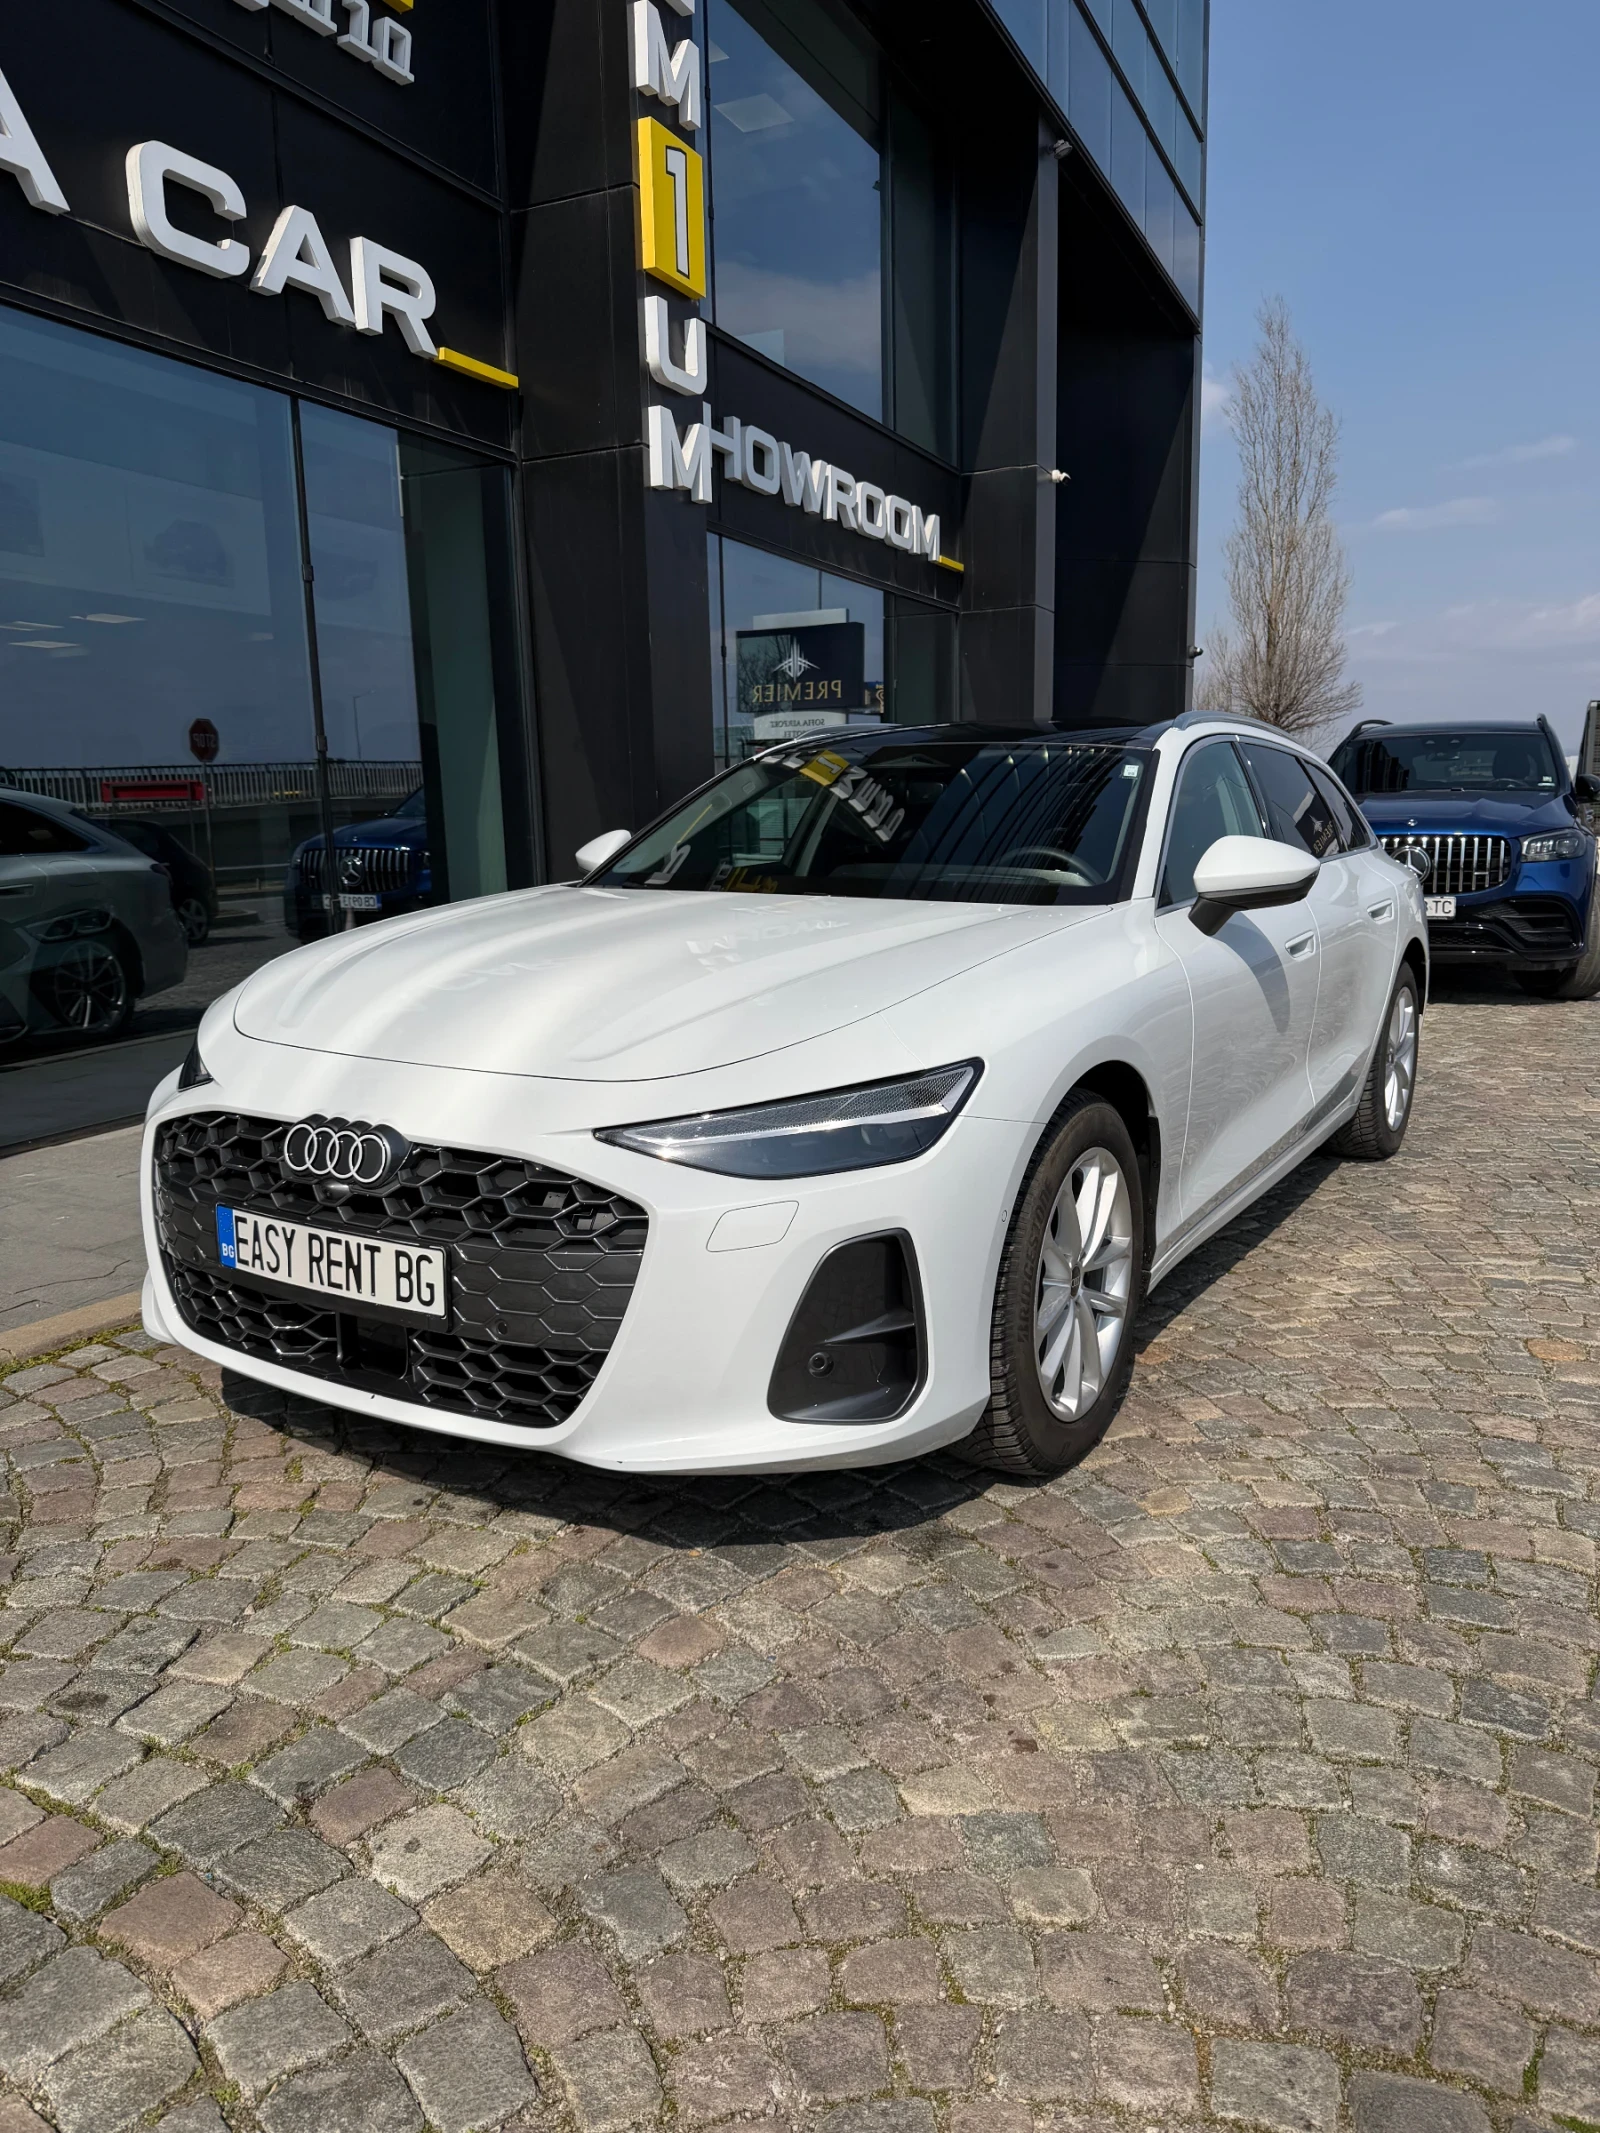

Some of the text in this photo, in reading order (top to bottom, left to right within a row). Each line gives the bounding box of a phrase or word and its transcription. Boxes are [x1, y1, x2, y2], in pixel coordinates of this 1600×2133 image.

[125, 140, 438, 361] CAR
[632, 0, 712, 504] M1UM
[702, 400, 940, 562] HOWROOM
[1432, 900, 1452, 914] TC
[221, 1243, 235, 1258] BG
[234, 1215, 436, 1307] EASY RENT BG
